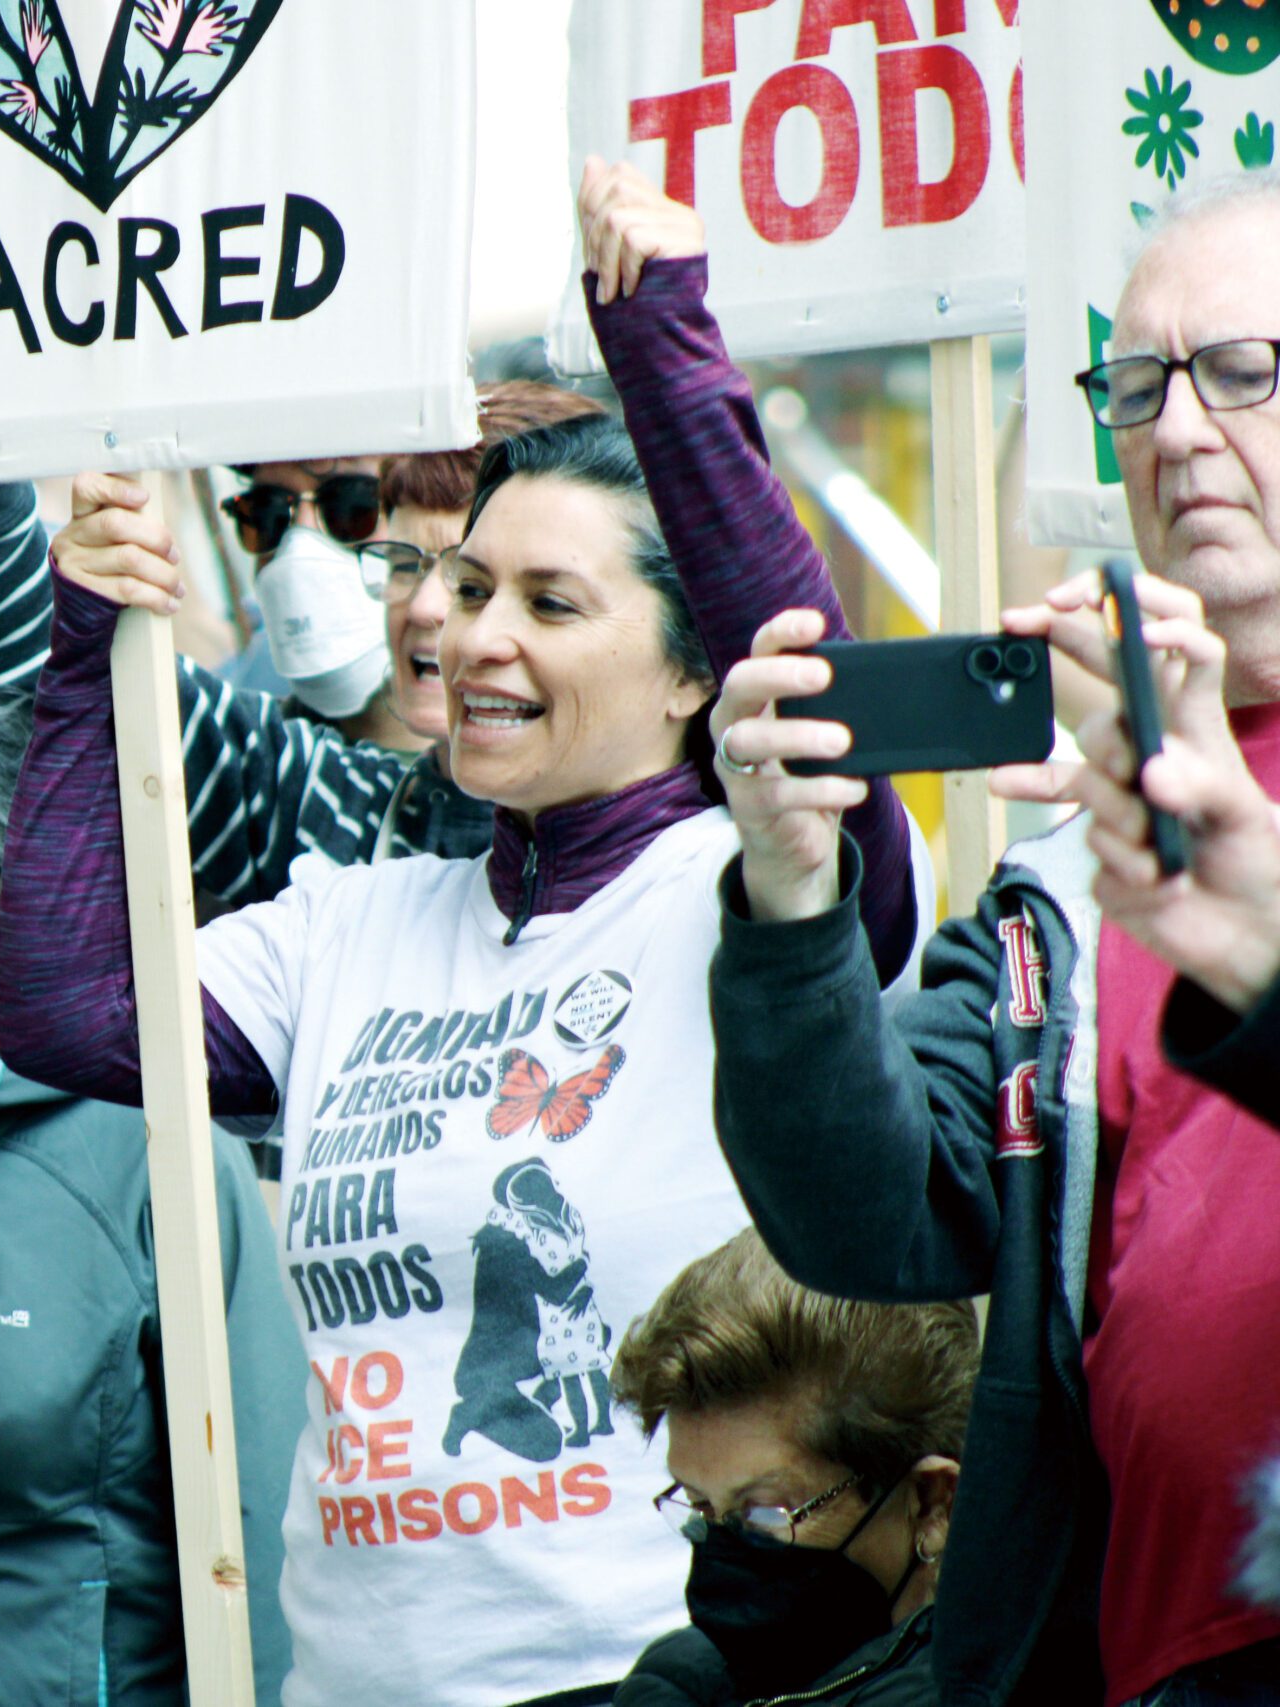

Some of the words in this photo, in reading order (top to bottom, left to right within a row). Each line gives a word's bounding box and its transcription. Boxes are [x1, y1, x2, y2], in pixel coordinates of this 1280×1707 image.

[629, 44, 1026, 245] TOD
[570, 1011, 612, 1027] SILENT
[571, 991, 587, 1001] WE
[591, 985, 614, 995] WILL
[571, 1003, 594, 1014] NOT
[599, 998, 613, 1006] BE
[314, 1081, 343, 1119] Y
[299, 1110, 447, 1173] HUMANOS
[286, 1167, 399, 1251] PARA
[289, 1244, 444, 1331] TODOS
[310, 1350, 404, 1416] NO
[317, 1419, 413, 1485] ICE
[318, 1462, 612, 1547] PRISONS
